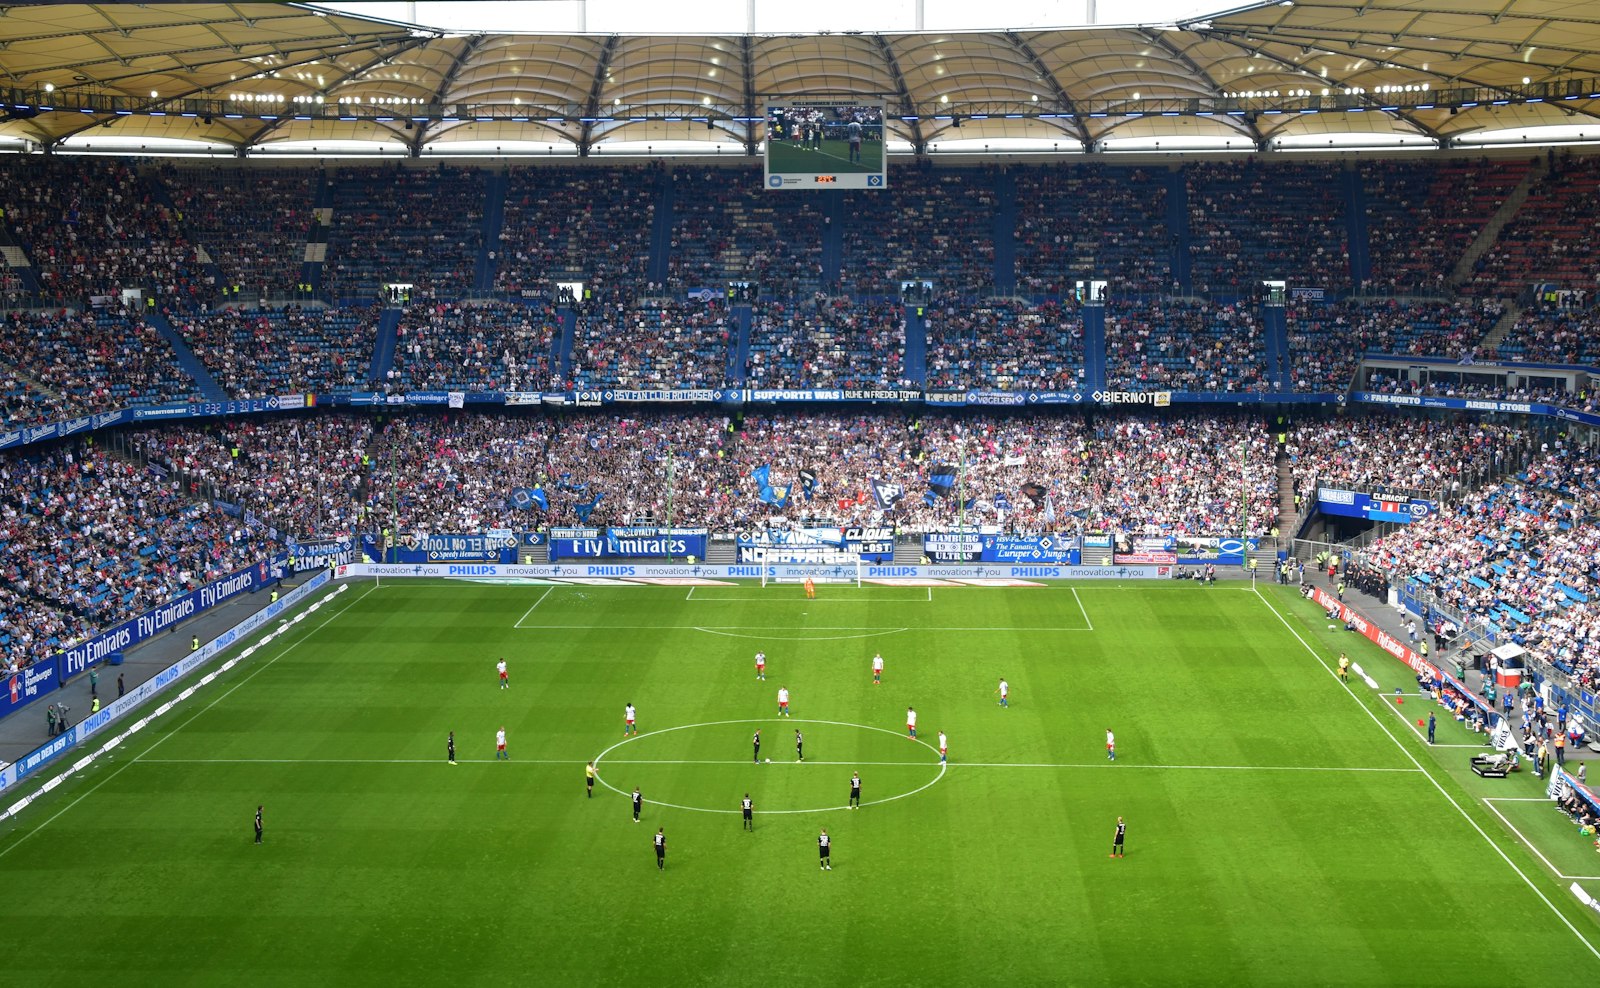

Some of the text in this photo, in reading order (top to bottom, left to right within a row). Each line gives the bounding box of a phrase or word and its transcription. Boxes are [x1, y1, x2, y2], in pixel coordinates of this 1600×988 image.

[614, 390, 713, 400] HSV FAN CLUB ROTHOSEN
[754, 391, 840, 400] SUPPORTE WAS
[846, 390, 920, 398] RUHE IN FRIEDEN TOMMY
[1103, 391, 1154, 404] BIERNOT
[1371, 394, 1420, 404] FAN-KONTO
[1466, 401, 1530, 412] ARENA STORE
[573, 538, 602, 556] Fly
[998, 550, 1032, 560] Luruper
[368, 566, 438, 576] innovation you
[450, 566, 496, 574] PHILIPS
[506, 566, 578, 576] innovation you
[588, 566, 636, 576] PHILIPS
[646, 567, 718, 577] innovation you
[786, 568, 858, 577] innovation you
[869, 567, 918, 576] PHILIPS
[928, 568, 1000, 578] innovation you
[1012, 568, 1060, 576] PHILIPS
[1070, 568, 1144, 578] innovation you
[200, 572, 252, 606] Fly Emirates
[138, 598, 194, 637] Fly Emirates
[216, 629, 236, 650] PHILIPS
[66, 628, 130, 673] Fly Emirates
[24, 668, 34, 678] Der
[24, 668, 52, 687] Hamburger
[156, 664, 178, 689] PHILIPS
[26, 685, 37, 696] Weg
[84, 708, 110, 734] PHILIPS
[27, 736, 66, 769] NUR DER HSV
